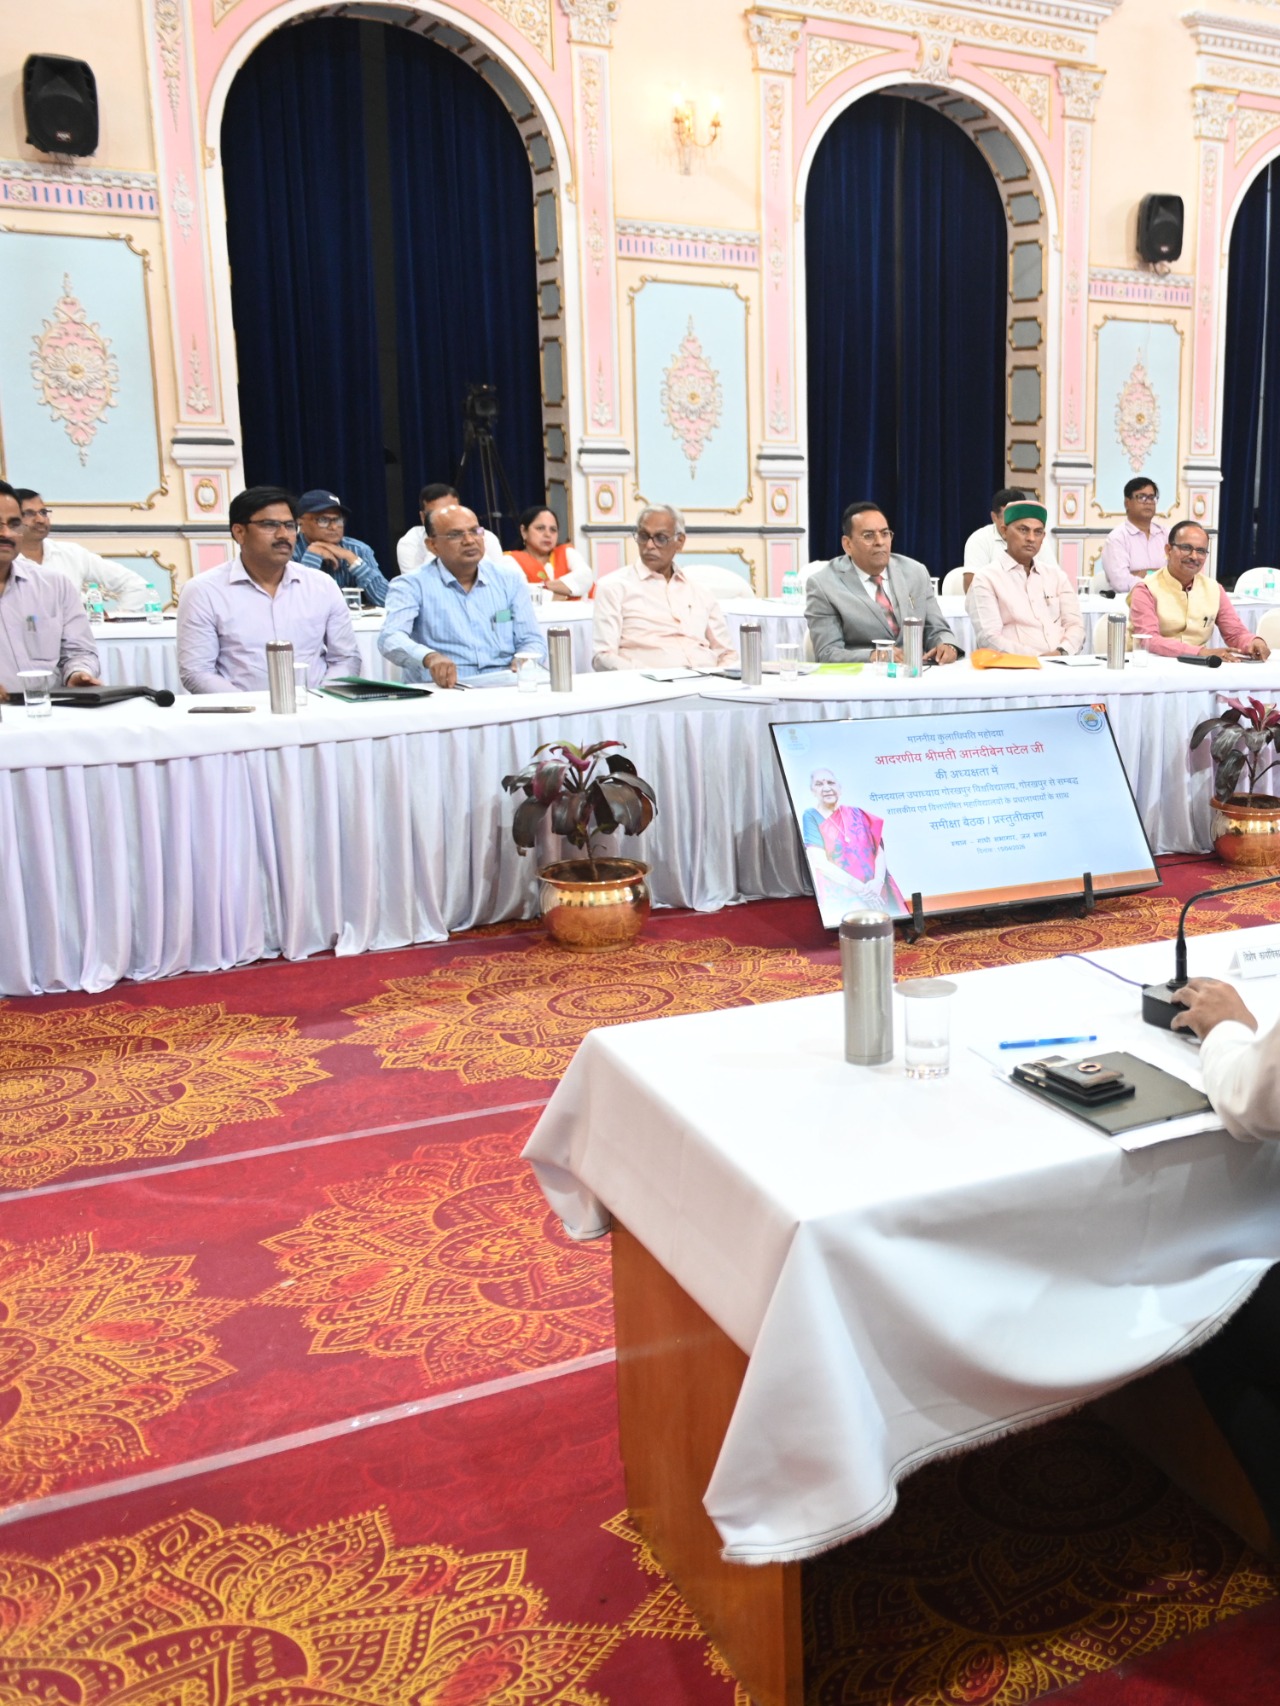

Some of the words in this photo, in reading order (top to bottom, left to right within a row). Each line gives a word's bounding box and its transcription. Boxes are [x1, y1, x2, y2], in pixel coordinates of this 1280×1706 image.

[906, 733, 936, 743] माननीय
[937, 731, 976, 744] कुलाधिपति
[977, 728, 1005, 739] महोदया
[874, 750, 922, 765] आदरणीय
[925, 748, 957, 761] श्रीमती
[959, 745, 1004, 759] आनंदीबेन
[1006, 743, 1029, 757] पटेल
[1030, 741, 1045, 754] जी
[934, 768, 948, 780] की
[950, 766, 990, 779] अध्यक्षता
[991, 764, 999, 775] में
[868, 791, 905, 802] दीनदयाल
[906, 788, 940, 799] उपाध्याय
[941, 786, 971, 798] गोरखपुर
[1019, 779, 1047, 790] गोरखपुर
[1048, 777, 1056, 787] से
[929, 817, 961, 831] समीक्षा
[963, 815, 985, 827] बैठक
[992, 810, 1045, 827] प्रस्तुतीकरण
